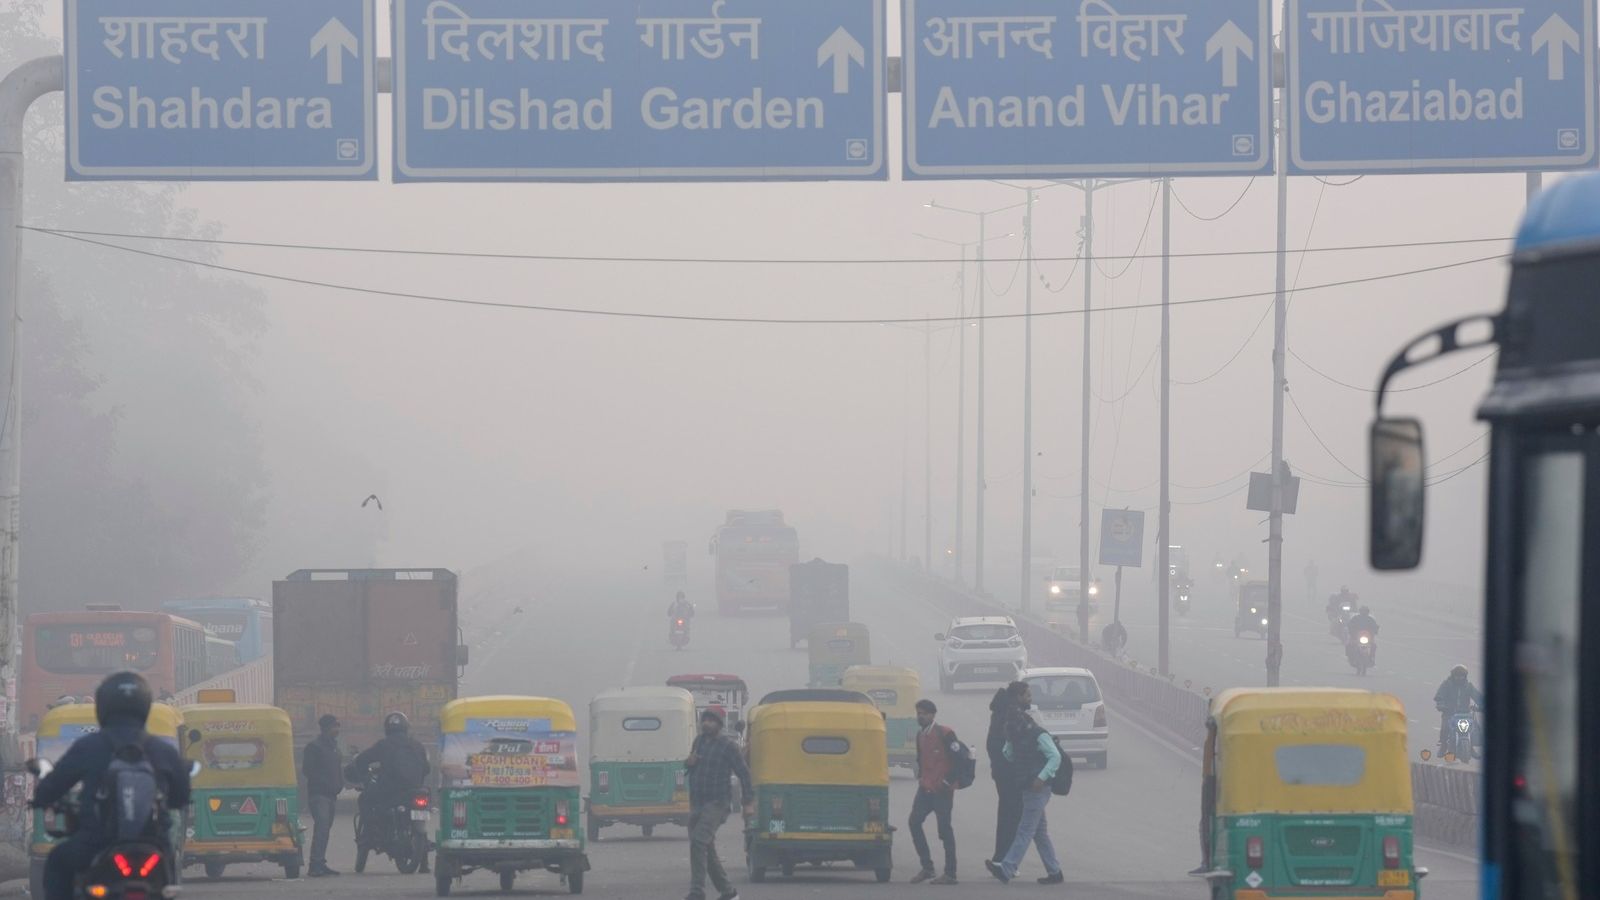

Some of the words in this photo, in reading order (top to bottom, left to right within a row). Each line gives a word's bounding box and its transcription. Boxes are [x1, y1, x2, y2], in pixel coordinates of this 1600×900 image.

[98, 16, 268, 65] शाहदरा
[421, 0, 609, 62] दिलशाद
[635, 0, 762, 61] गार्डन
[922, 15, 1057, 60] आनन्द
[1075, 0, 1188, 63] विहार
[1306, 0, 1525, 54] गाजियाबाद
[91, 85, 333, 130] Shahdara
[422, 87, 613, 131] Dilshad
[640, 86, 825, 131] Garden
[927, 84, 1085, 128] Anand
[1101, 83, 1231, 127] Vihar
[1304, 76, 1524, 124] Ghaziabad
[480, 755, 506, 765] CASH
